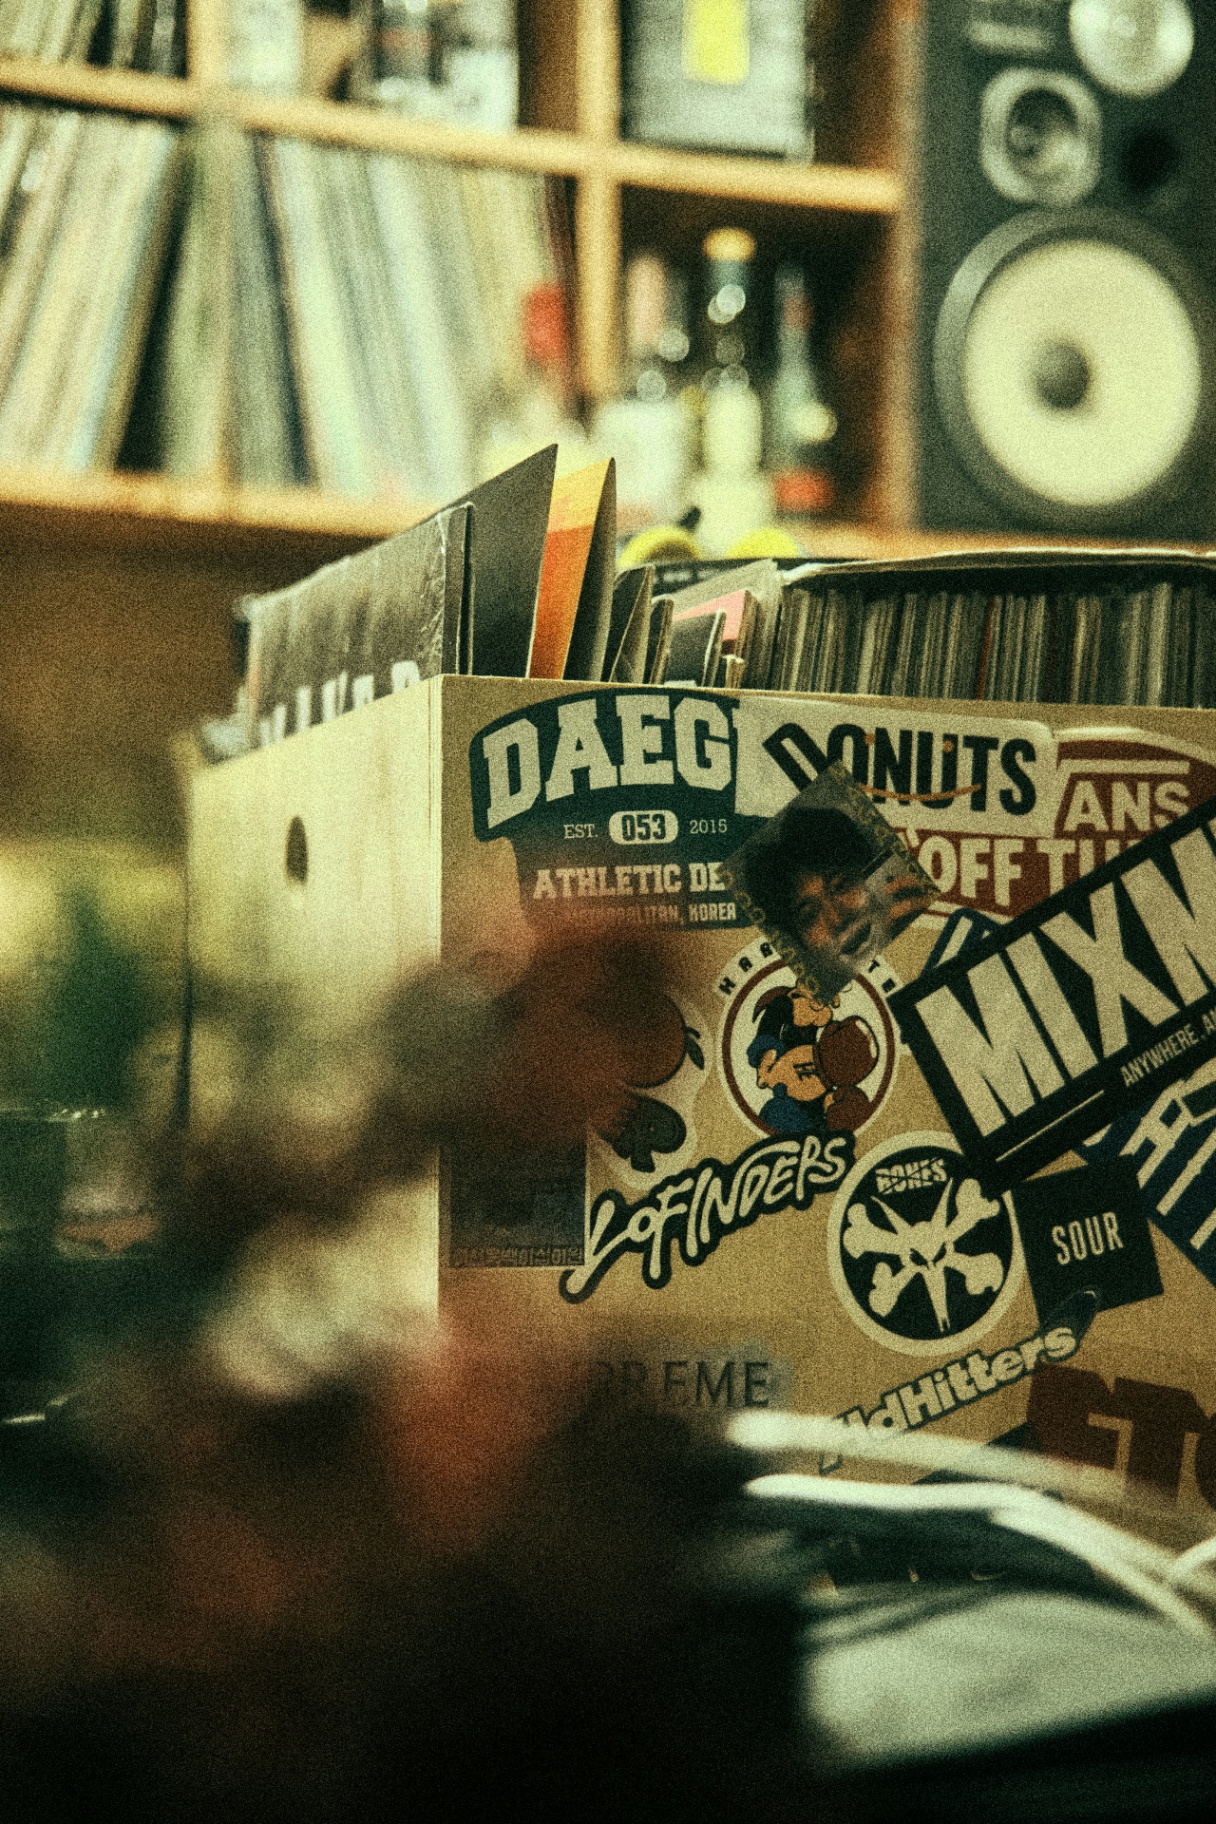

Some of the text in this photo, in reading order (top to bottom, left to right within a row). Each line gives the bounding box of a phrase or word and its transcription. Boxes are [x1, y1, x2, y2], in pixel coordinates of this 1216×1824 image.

[482, 694, 740, 830] DAEG
[762, 722, 1037, 816] DONUTS
[1060, 759, 1191, 833] ANS
[563, 813, 728, 841] EST. 053 2015
[532, 864, 683, 901] ATHLETIC
[688, 902, 737, 922] KOREA
[914, 819, 1216, 1137] MIXM
[875, 1158, 947, 1195] BONES
[1051, 1210, 1124, 1266] SOUR
